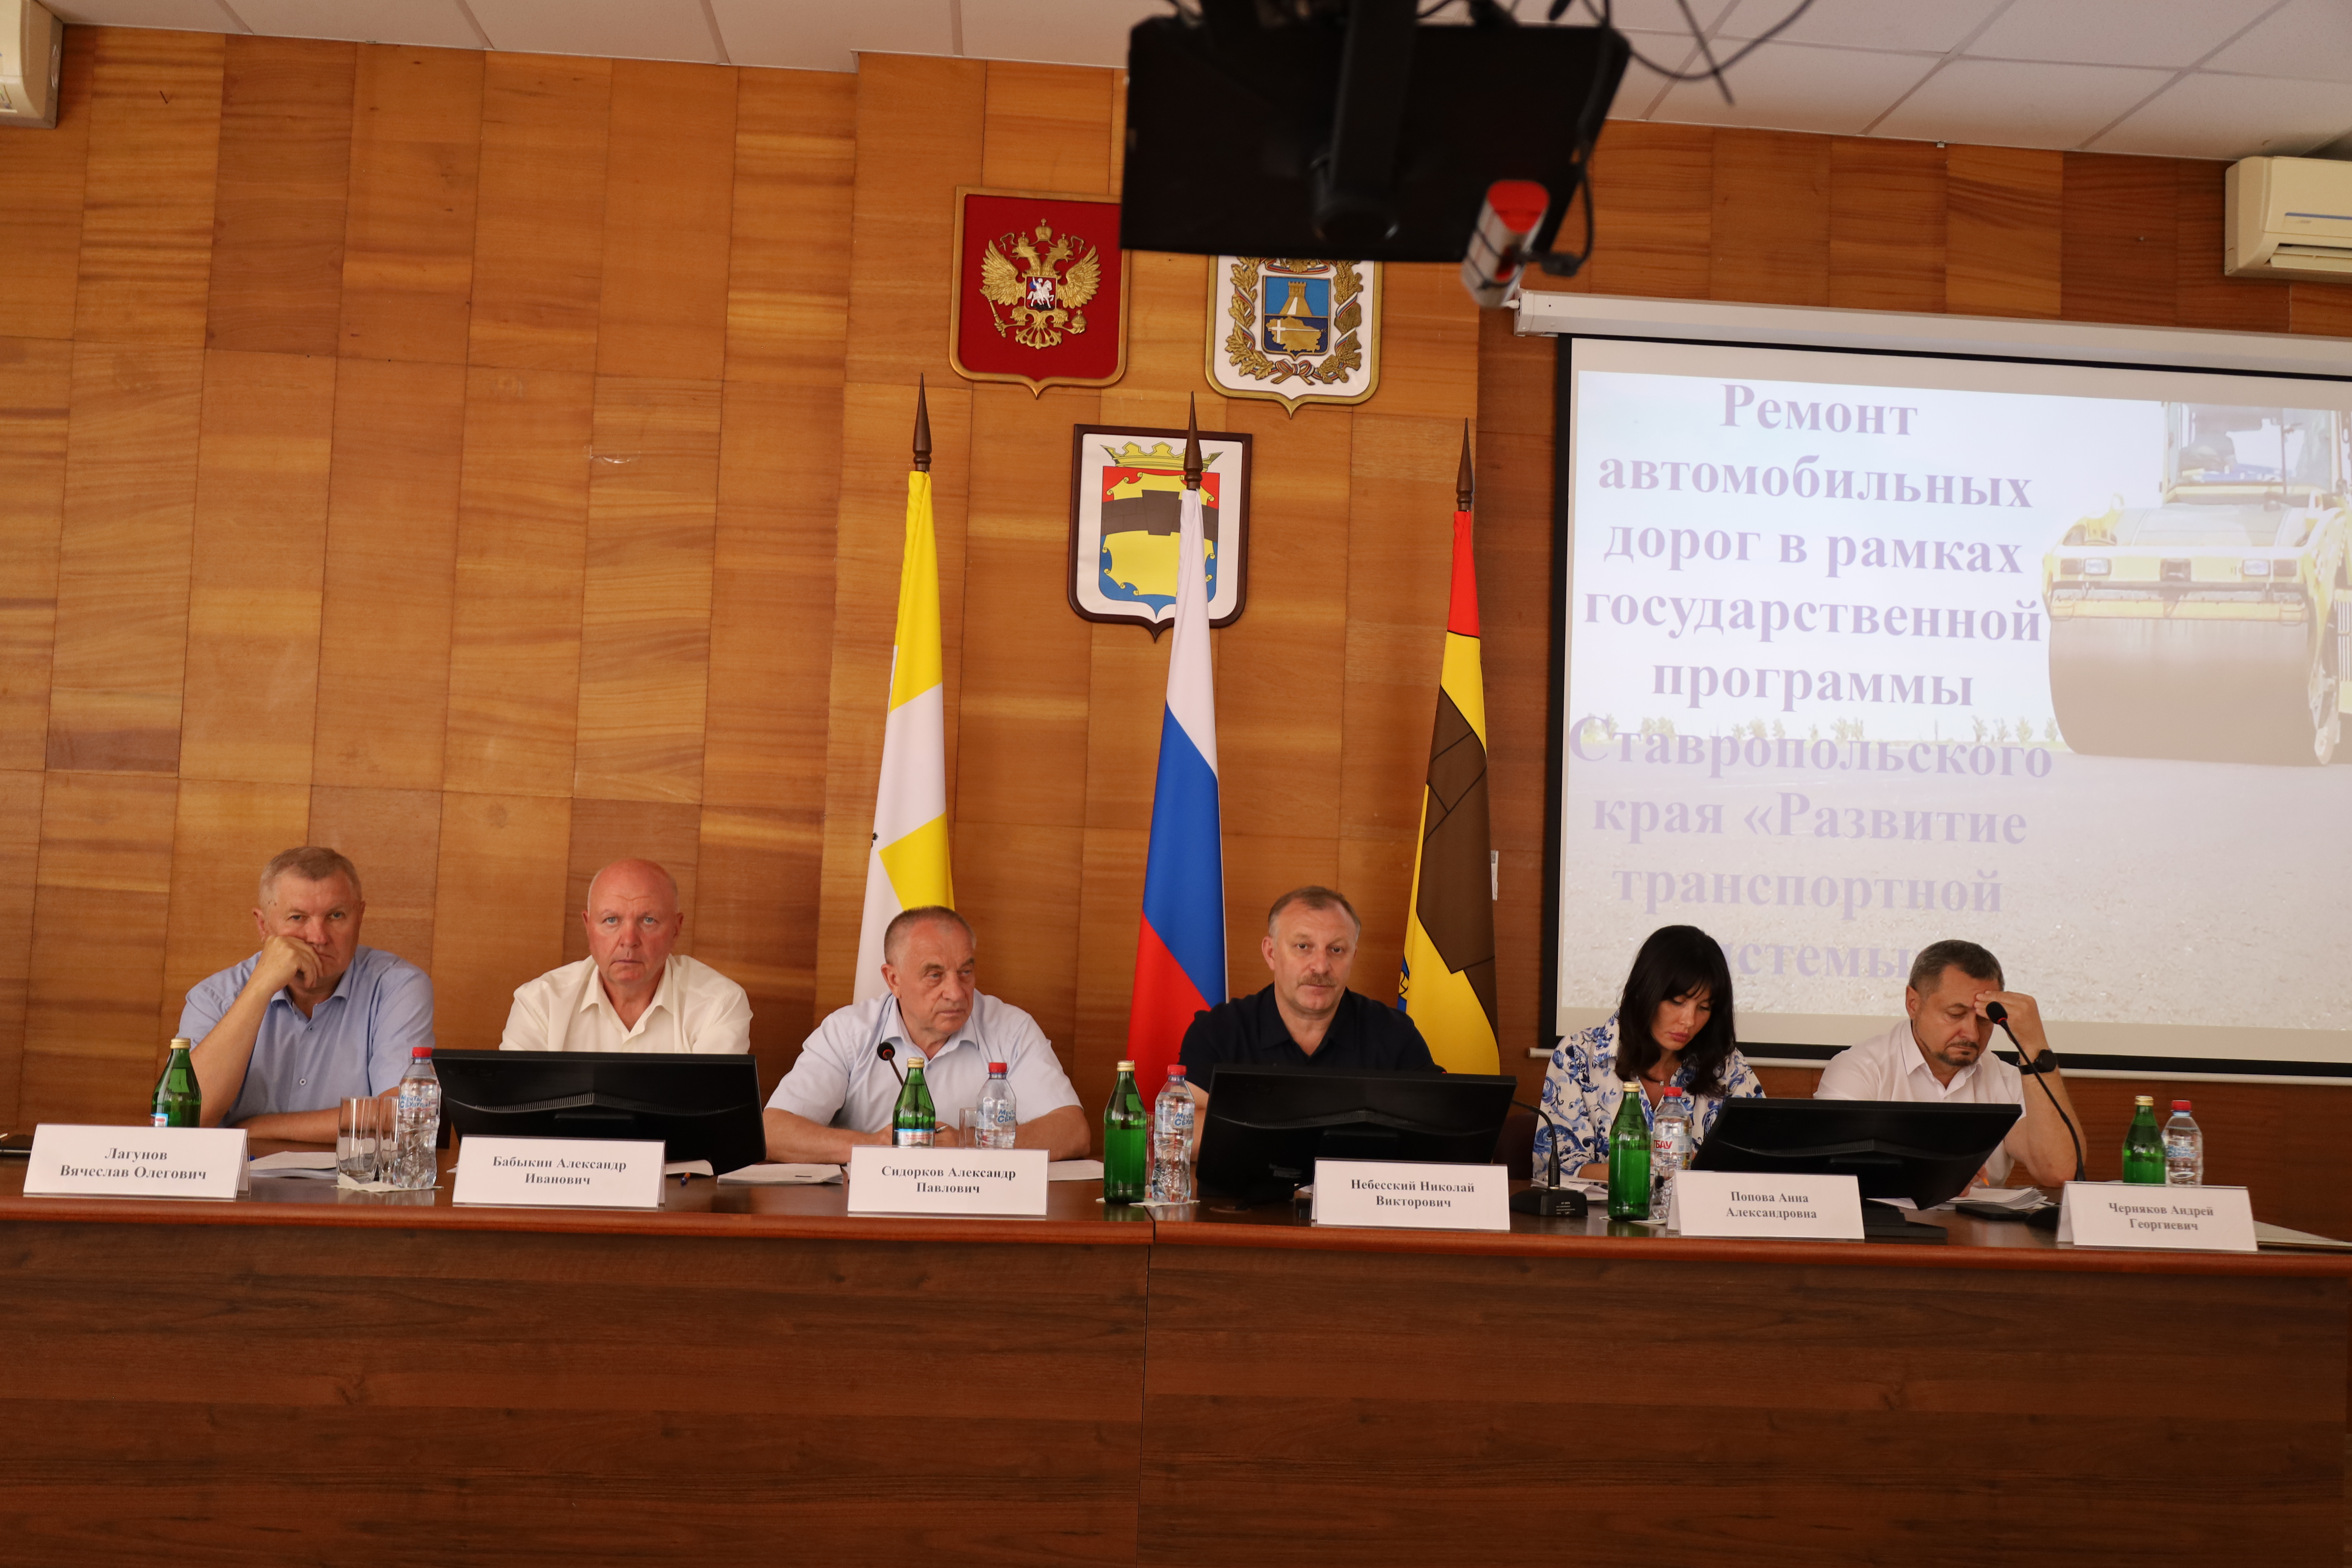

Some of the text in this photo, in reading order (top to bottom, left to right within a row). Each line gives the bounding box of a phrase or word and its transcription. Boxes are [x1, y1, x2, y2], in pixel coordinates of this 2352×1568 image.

[1721, 383, 1919, 436] Ремонт
[1598, 455, 2033, 509] автомобильных
[1603, 526, 2023, 578] дорог в рамках
[1584, 591, 2041, 643] государственной
[1652, 664, 1973, 712] программы
[1568, 715, 2053, 779] Ставропольского
[1592, 792, 2027, 845] края «Развитие
[1612, 868, 2002, 921] транспортной
[1720, 943, 1919, 978] стемы
[104, 1147, 168, 1163] Лагунов
[60, 1164, 207, 1180] Вячеслав Олегович
[492, 1156, 627, 1172] Бабыкин Александр
[524, 1173, 591, 1185] Иванович
[881, 1165, 1016, 1181] Сидорков Александр
[916, 1182, 980, 1194] Павлович
[1351, 1179, 1475, 1193] Небесский Николай
[1376, 1195, 1452, 1209] Викторович
[1730, 1191, 1809, 1203] Попова Анна
[1726, 1207, 1817, 1220] Александровна
[2109, 1202, 2214, 1217] Черняков Андрей
[2129, 1218, 2198, 1231] Георгиевич
